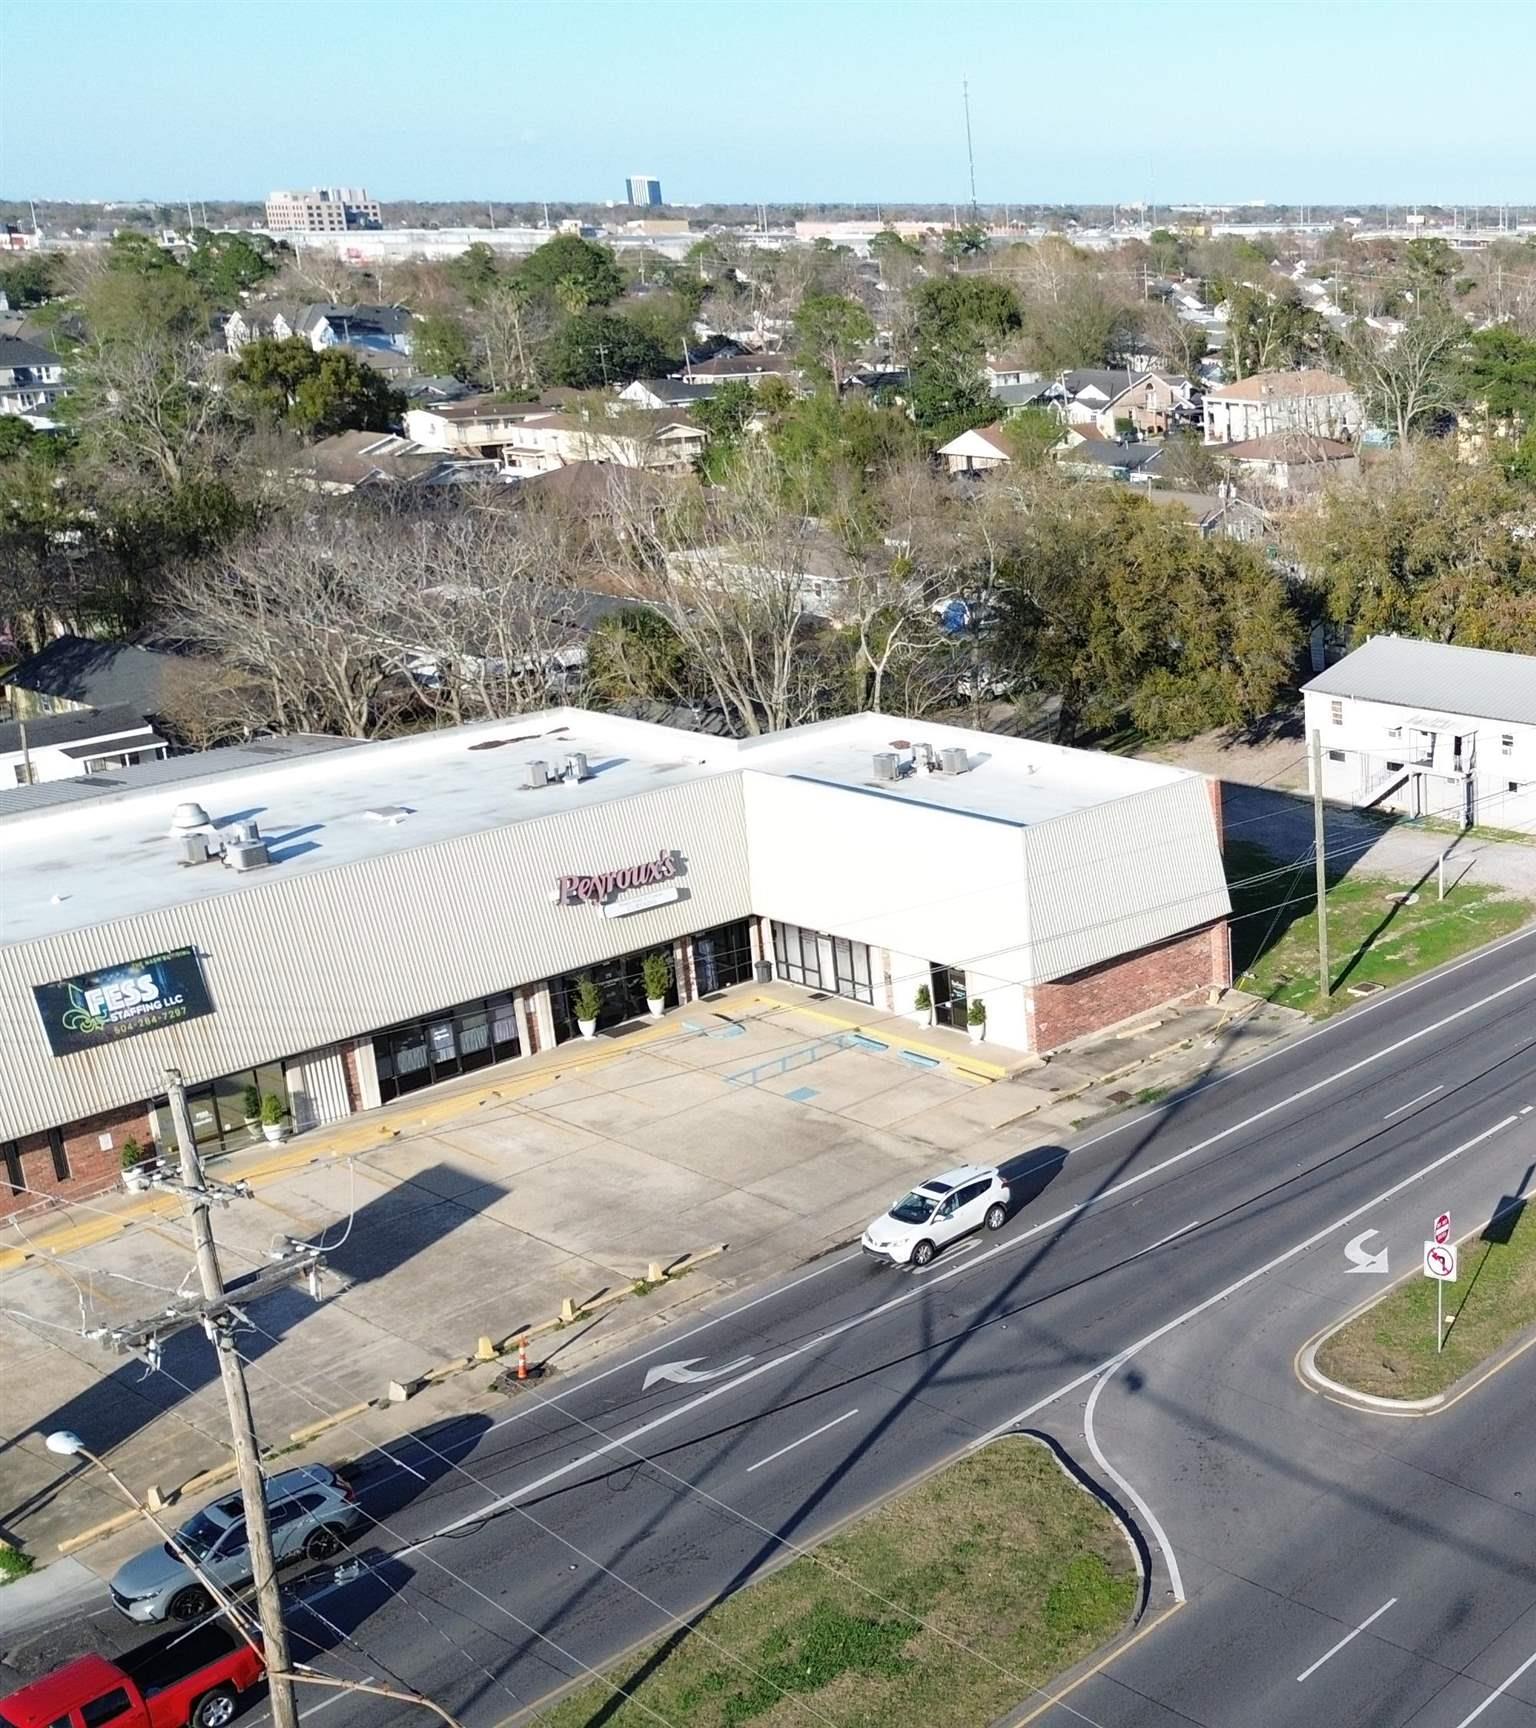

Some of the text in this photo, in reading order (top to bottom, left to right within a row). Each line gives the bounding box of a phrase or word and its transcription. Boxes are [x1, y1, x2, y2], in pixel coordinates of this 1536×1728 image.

[556, 849, 677, 907] Peyroux's
[84, 974, 160, 1017] FESS
[110, 994, 184, 1023] STAFFING LLC
